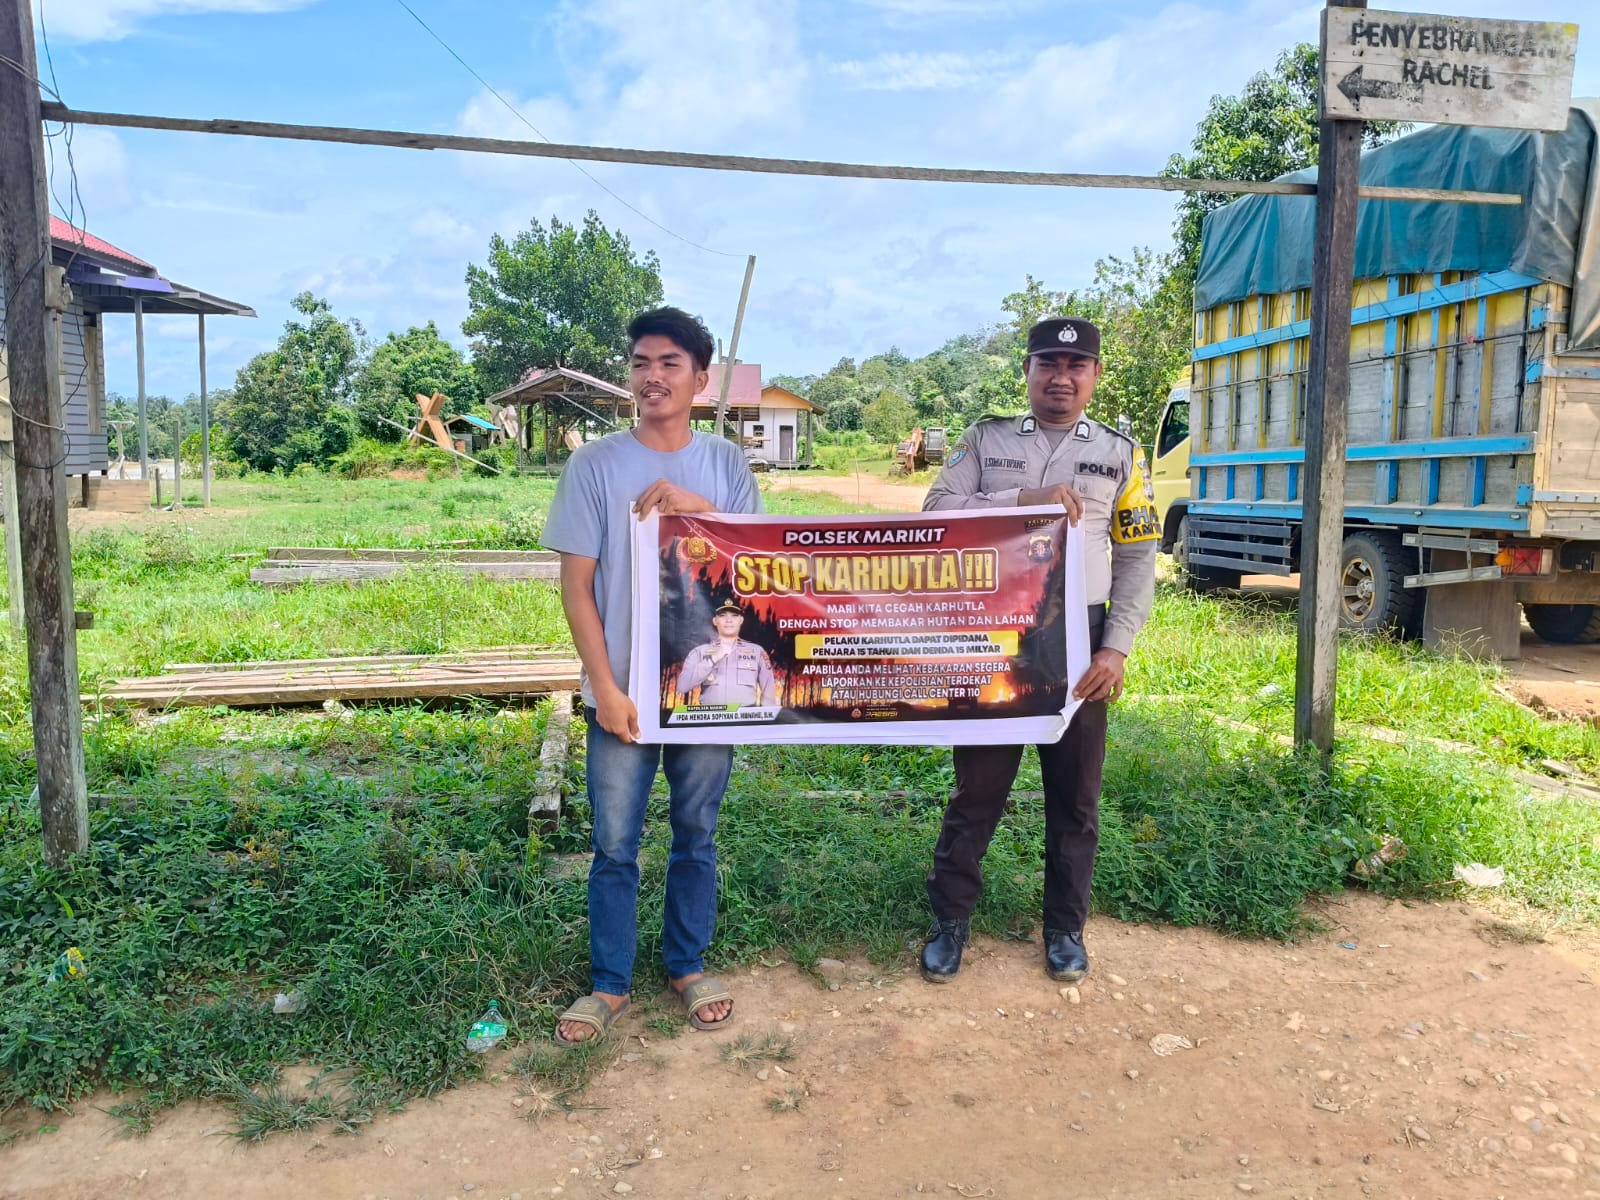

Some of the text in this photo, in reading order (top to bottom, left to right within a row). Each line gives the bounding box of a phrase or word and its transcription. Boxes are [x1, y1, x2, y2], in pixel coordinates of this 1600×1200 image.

[1402, 58, 1496, 91] RACHEL
[1079, 463, 1118, 480] POLRI
[785, 528, 945, 545] POLSEK MARIKIT
[737, 555, 808, 592] STOP
[815, 553, 959, 592] KARHUTLA
[827, 601, 985, 614] MARI KITA CEGAH KARHUTLA
[779, 614, 1034, 629] DENGAN STOP MEMBAKAR HUTAN DAN LAHAN
[824, 634, 989, 645] PELAKU KARHUTLA DAPAT DIPIDANA
[812, 648, 856, 656] PENJARA
[857, 648, 866, 656] 15
[866, 647, 899, 656] TAHUN
[901, 646, 920, 655] DAN
[922, 646, 954, 654] DENDA
[966, 645, 1000, 654] MILYAR
[802, 662, 1011, 674] APABILA ANDA MELIHAT KEBAKARAN SEGERA
[822, 675, 992, 687] LAPORKAN KE KEPOLISIAN TERDEKAT
[832, 688, 980, 700] ATAU HUBUNGI CALL CENTER 110
